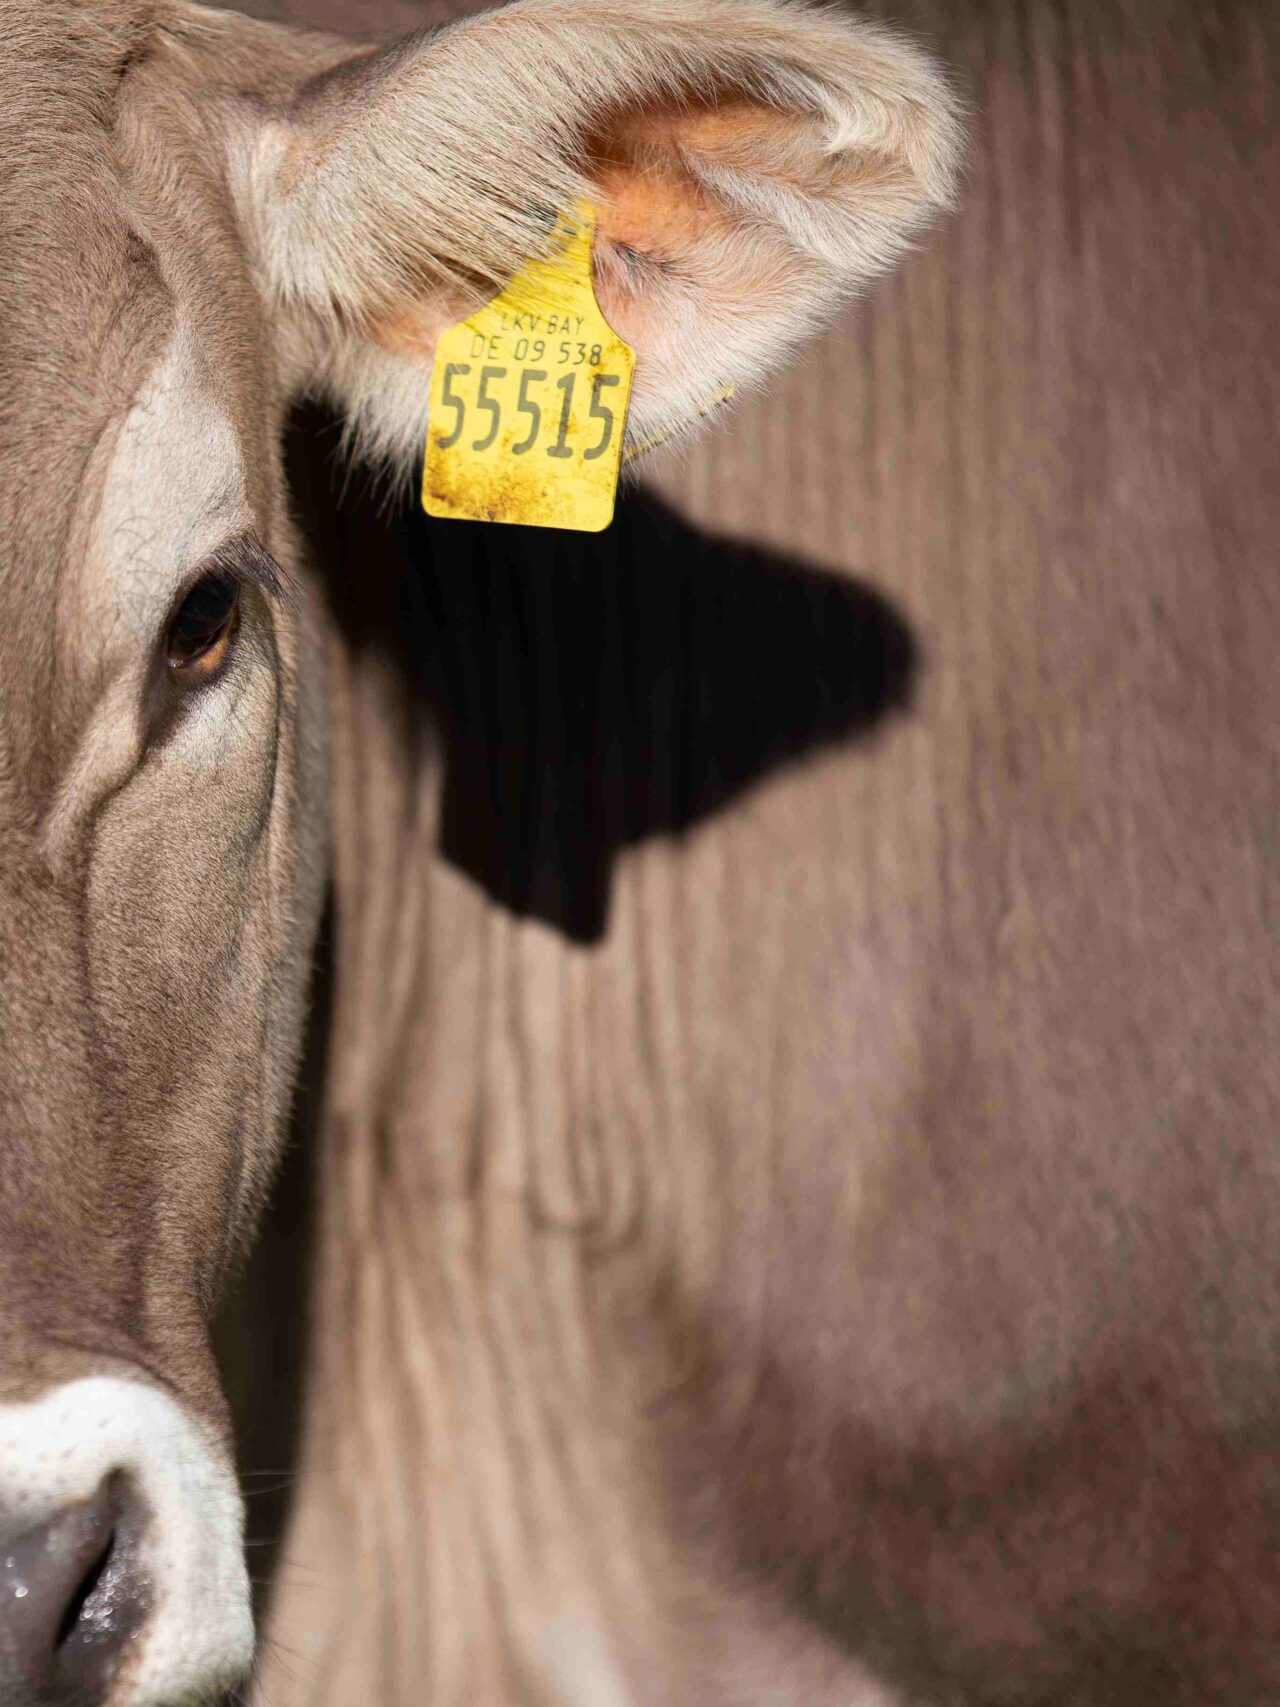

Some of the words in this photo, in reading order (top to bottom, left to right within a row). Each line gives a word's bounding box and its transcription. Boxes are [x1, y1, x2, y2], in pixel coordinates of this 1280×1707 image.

[501, 313, 541, 332] LKV
[548, 314, 586, 336] BAY
[471, 334, 502, 360] DE
[515, 338, 546, 362] 09
[558, 341, 603, 367] 538
[437, 363, 621, 461] 55515
